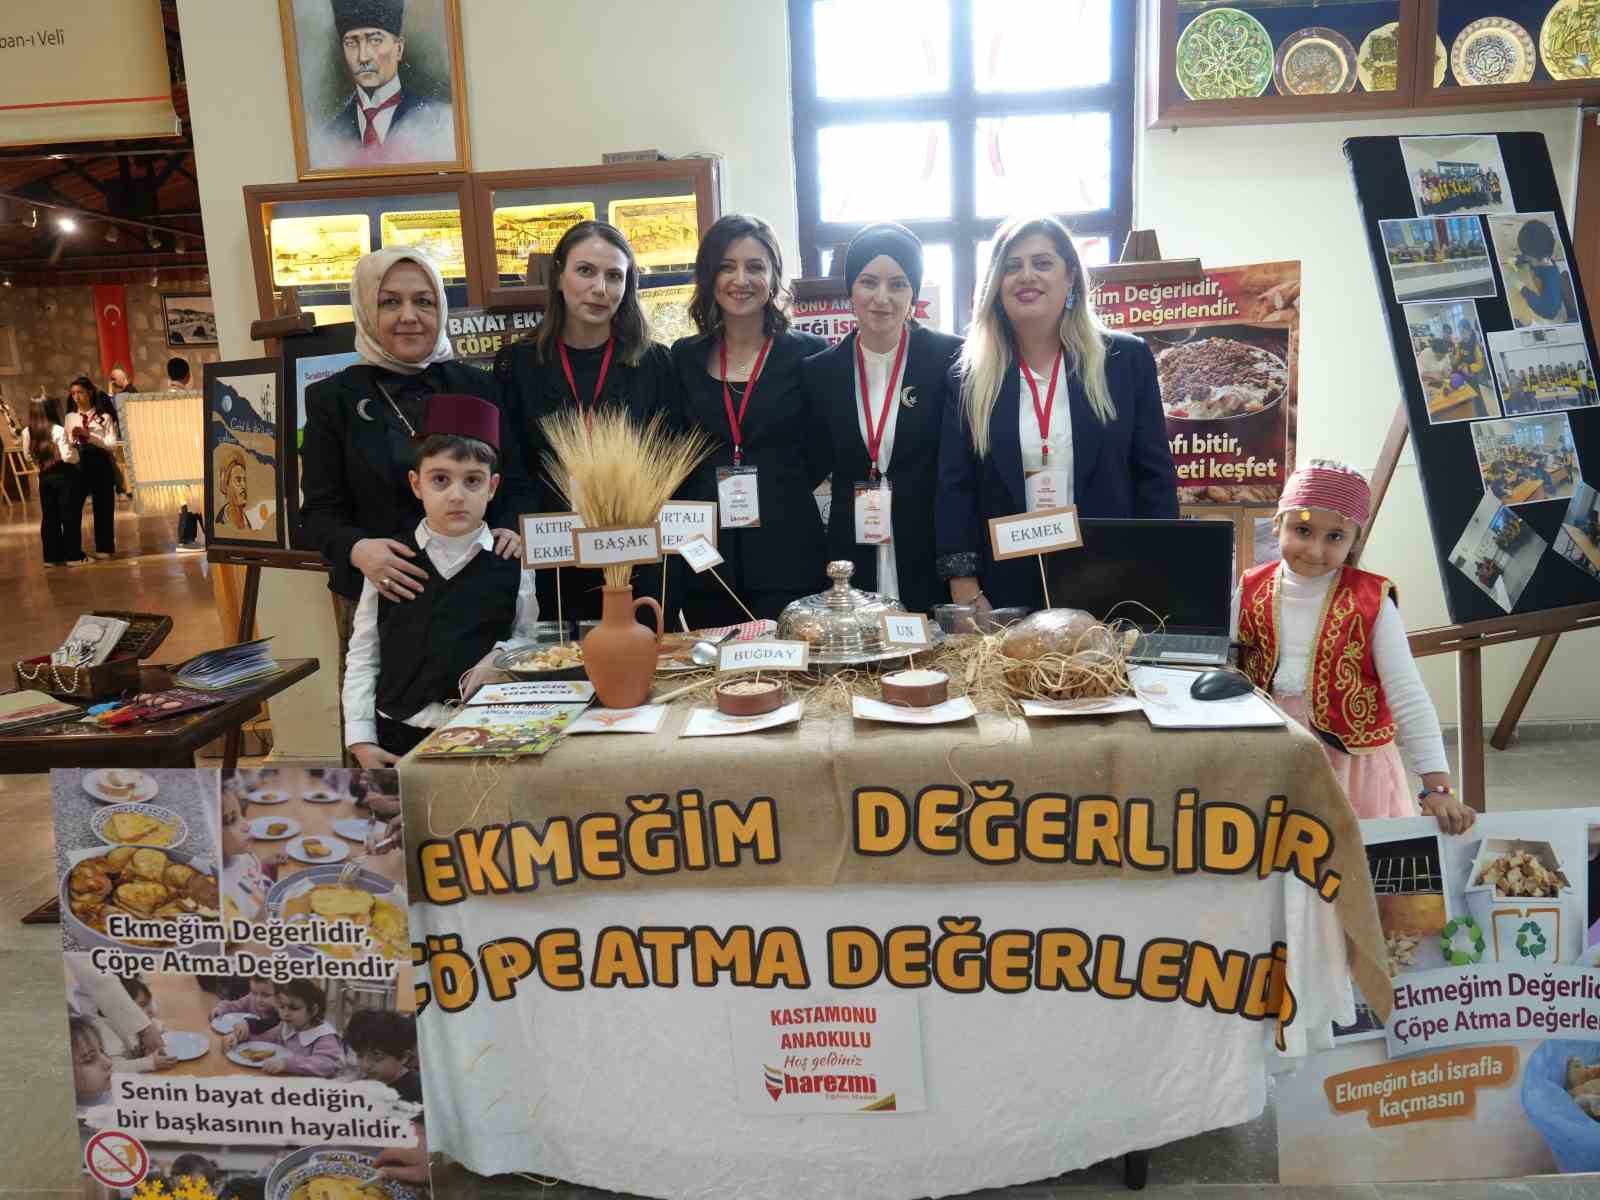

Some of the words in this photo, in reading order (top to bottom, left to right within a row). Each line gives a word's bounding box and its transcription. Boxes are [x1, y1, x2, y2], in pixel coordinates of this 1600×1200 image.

[1125, 279, 1223, 304] Değerlidir,
[1129, 298, 1240, 325] Değerlendir.
[448, 314, 506, 336] BAYAT
[456, 334, 503, 359] ÇÖPE
[1192, 432, 1242, 456] bitir,
[1175, 458, 1205, 479] eti
[1210, 456, 1278, 482] keşfet
[535, 520, 573, 534] KITIR
[661, 511, 704, 523] RTALI
[594, 534, 649, 551] BAŞAK
[1010, 522, 1064, 542] EKMEK
[896, 625, 914, 637] UN
[734, 648, 797, 661] BUĞDAY
[417, 788, 781, 905] EKMEĞİM
[853, 780, 1342, 902] DEĞERLİDİR,
[109, 916, 224, 945] Ekmeğim
[233, 919, 372, 947] Değerlidir,
[91, 950, 155, 974] Çöpe
[162, 954, 230, 975] Atma
[239, 955, 395, 980] Değerlendir
[591, 924, 811, 990] ATMA
[1393, 975, 1502, 1010] Ekmeğim
[771, 1006, 877, 1026] KASTAMONU
[1394, 1016, 1449, 1045] Çöpe
[1455, 1011, 1511, 1031] Atma
[1516, 1005, 1600, 1032] Değerle
[781, 1031, 871, 1050] ANAOKULU
[784, 1054, 808, 1070] Hoş
[812, 1051, 864, 1071] geldiniz
[1411, 1064, 1443, 1087] tadı
[1447, 1056, 1503, 1080] israfla
[783, 1072, 878, 1094] harezmi
[121, 1081, 188, 1101] Senin
[196, 1083, 262, 1108] bayat
[271, 1086, 374, 1111] dediğin,
[1380, 1090, 1465, 1119] kaçmasın
[117, 1109, 149, 1128] bir
[156, 1111, 284, 1135] başkasının
[292, 1117, 407, 1140] hayalidir.
